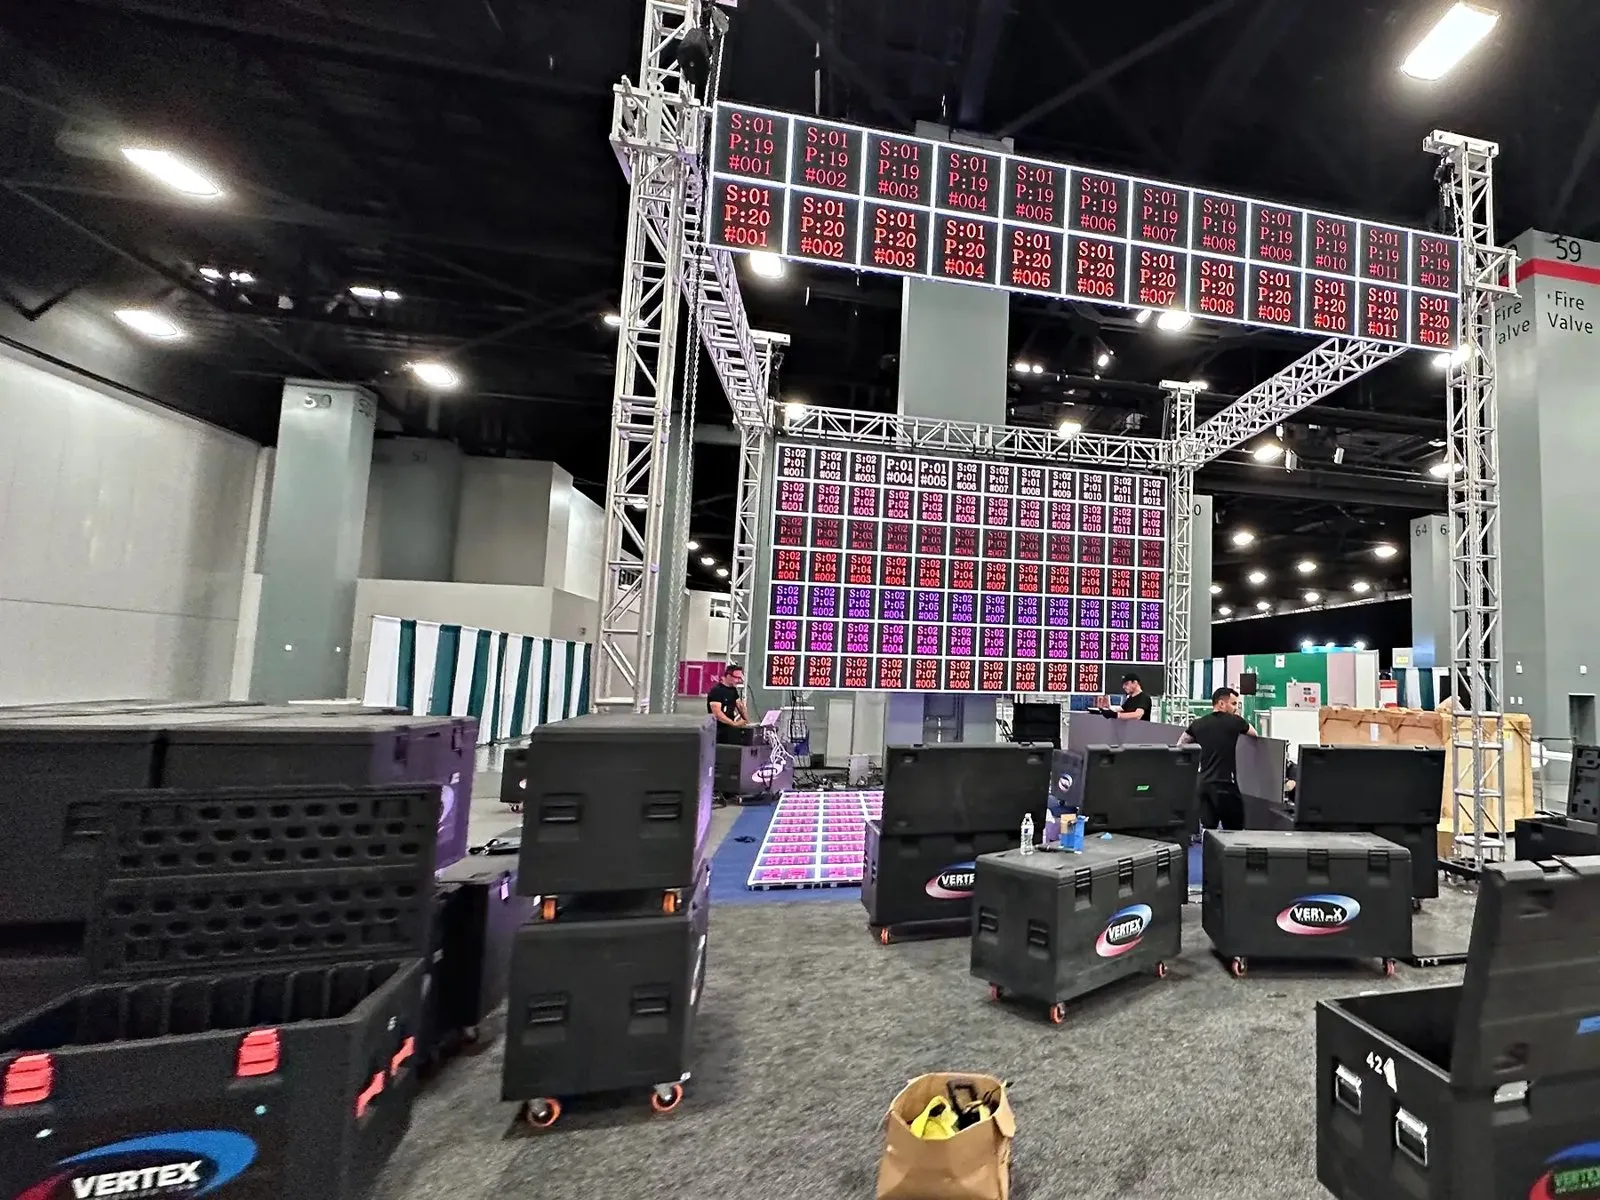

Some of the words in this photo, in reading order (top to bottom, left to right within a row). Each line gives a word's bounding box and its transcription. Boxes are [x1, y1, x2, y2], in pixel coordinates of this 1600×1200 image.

[731, 112, 773, 136] S:01
[729, 132, 774, 155] P:19
[807, 126, 848, 149] S:01
[805, 145, 849, 168] P:19
[880, 140, 919, 161] S:01
[728, 153, 770, 176] #001
[878, 159, 920, 181] P:19
[950, 152, 987, 174] S:01
[805, 167, 847, 188] #002
[948, 171, 989, 193] P:19
[1017, 164, 1053, 185] S:01
[726, 184, 770, 207] S:01
[878, 179, 919, 200] #003
[1016, 183, 1054, 203] P:19
[1081, 176, 1116, 197] S:01
[803, 196, 845, 218] S:01
[948, 191, 988, 212] #004
[1081, 194, 1118, 215] P:19
[1143, 188, 1177, 207] S:01
[724, 204, 771, 227] P:20
[1015, 202, 1053, 223] #005
[1143, 205, 1179, 225] P:19
[1203, 198, 1236, 218] S:01
[800, 215, 845, 238] P:20
[876, 208, 916, 230] S:01
[1080, 213, 1117, 233] #006
[1202, 216, 1237, 235] P:19
[1260, 209, 1292, 228] S:01
[724, 225, 768, 248] #001
[874, 227, 917, 249] P:20
[946, 219, 985, 241] S:01
[1142, 224, 1177, 243] #007
[1260, 226, 1293, 245] P:19
[1316, 219, 1346, 238] S:01
[1369, 228, 1399, 247] S:01
[800, 236, 844, 258] #002
[944, 238, 986, 259] P:20
[1014, 230, 1052, 251] S:01
[1202, 234, 1236, 252] #008
[1315, 236, 1347, 254] P:19
[1420, 238, 1449, 256] S:01
[1556, 238, 1582, 262] 59
[874, 247, 916, 269] #003
[1012, 248, 1052, 270] P:20
[1078, 240, 1115, 261] S:01
[1141, 250, 1176, 270] S:01
[1259, 244, 1293, 262] #009
[1369, 245, 1400, 263] P:19
[944, 257, 985, 279] #004
[1077, 258, 1115, 279] P:20
[1201, 260, 1235, 280] S:01
[1315, 254, 1347, 271] #010
[1368, 262, 1398, 280] #011
[1420, 254, 1450, 272] P:19
[1012, 267, 1051, 288] #005
[1139, 268, 1176, 288] P:20
[1200, 277, 1235, 297] P:20
[1259, 269, 1291, 289] S:01
[1420, 271, 1450, 289] #012
[1077, 277, 1115, 298] #006
[1139, 287, 1176, 306] #007
[1257, 286, 1292, 306] P:20
[1314, 278, 1346, 297] S:01
[1368, 287, 1398, 305] S:01
[1200, 295, 1235, 315] #008
[1313, 295, 1347, 314] P:20
[1419, 295, 1449, 313] S:01
[1555, 291, 1585, 311] Fire
[1258, 304, 1292, 323] #009
[1314, 312, 1346, 331] #010
[1367, 303, 1399, 322] P:20
[1419, 311, 1450, 330] P:20
[1367, 321, 1398, 339] #011
[1495, 320, 1530, 344] alve
[1547, 312, 1593, 334] Valve
[1419, 328, 1450, 346] #012
[854, 462, 876, 474] P:01
[855, 453, 877, 465] S:02
[886, 458, 914, 472] P:01
[920, 461, 947, 475] P:01
[989, 465, 1010, 476] S:02
[989, 474, 1009, 485] P:01
[818, 484, 841, 495] S:02
[1142, 487, 1161, 498] P:01
[1143, 479, 1162, 489] S:02
[817, 493, 840, 505] P:02
[1052, 502, 1072, 513] S:02
[1051, 511, 1071, 522] P:02
[1142, 509, 1161, 519] S:02
[1142, 517, 1161, 528] P:02
[815, 552, 837, 563] S:02
[953, 560, 974, 571] S:02
[814, 562, 837, 573] P:04
[953, 569, 974, 580] P:04
[1050, 566, 1070, 576] S:02
[1050, 574, 1070, 585] P:04
[776, 585, 799, 596] S:02
[952, 593, 973, 604] S:02
[776, 595, 799, 606] P:05
[952, 602, 973, 613] P:05
[1080, 599, 1100, 609] S:02
[1080, 608, 1100, 618] P:05
[811, 621, 834, 632] S:02
[984, 628, 1005, 638] S:02
[811, 631, 834, 642] P:06
[984, 637, 1005, 647] P:06
[1110, 632, 1130, 643] S:02
[1110, 641, 1130, 651] P:06
[772, 655, 796, 666] S:02
[950, 660, 971, 670] S:02
[983, 661, 1004, 671] S:02
[1079, 664, 1099, 674] S:02
[772, 665, 795, 676] P:07
[949, 669, 971, 680] P:07
[983, 670, 1004, 680] P:07
[1079, 673, 1099, 683] P:07
[941, 873, 976, 887] VERTE
[1108, 917, 1141, 941] VERTEX
[73, 1160, 202, 1199] VERTEX
